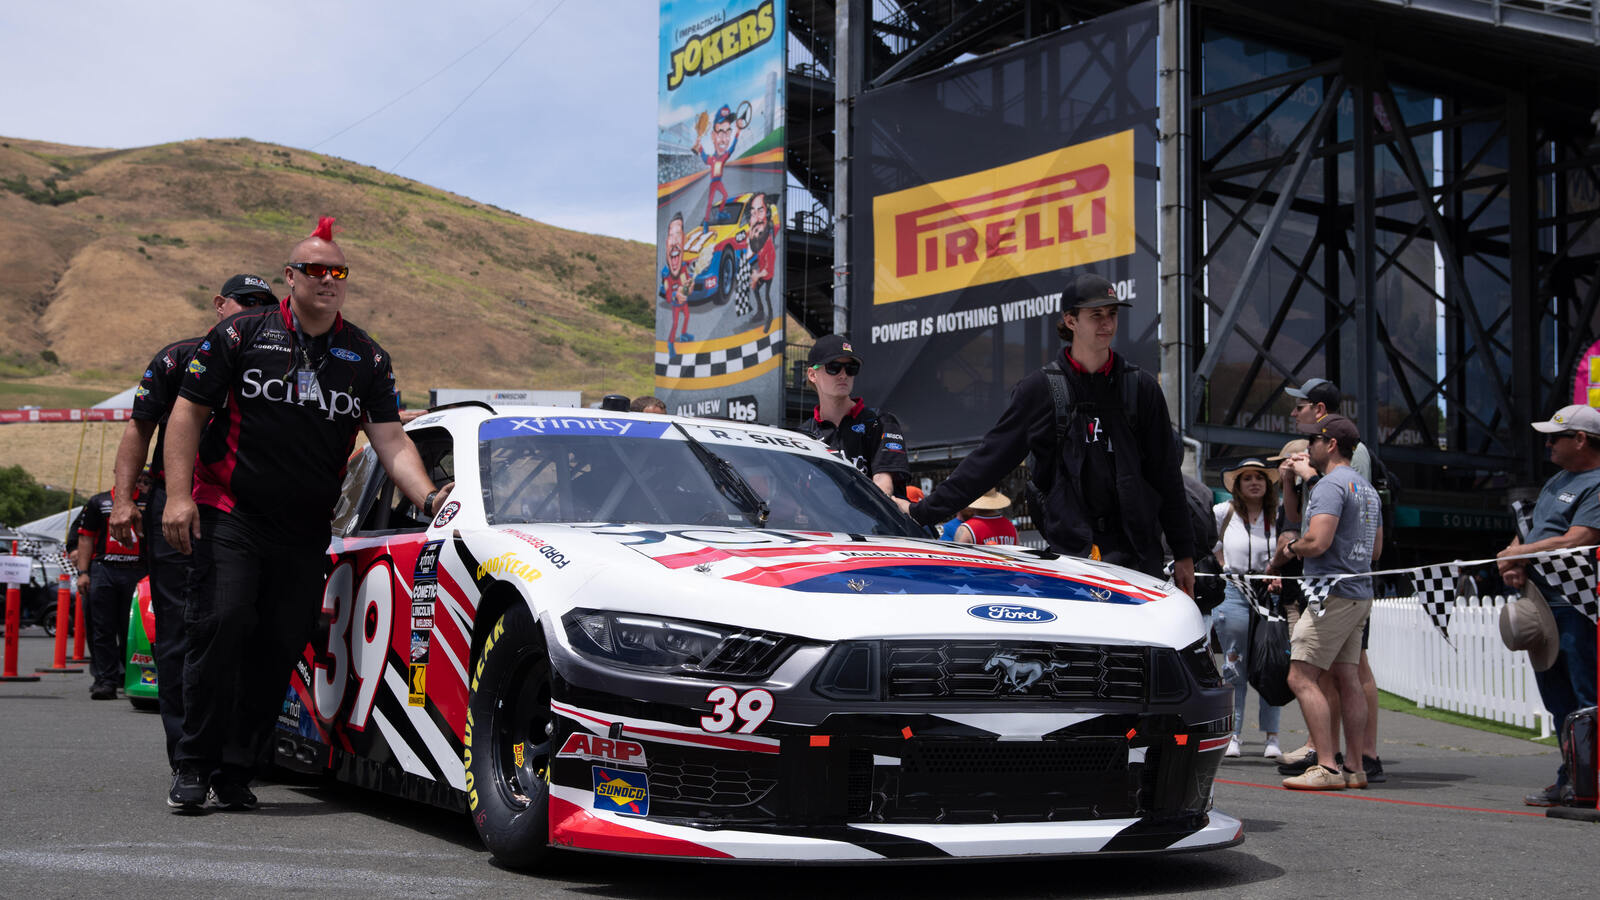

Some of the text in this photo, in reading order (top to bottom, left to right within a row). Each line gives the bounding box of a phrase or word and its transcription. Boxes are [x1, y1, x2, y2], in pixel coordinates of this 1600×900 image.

[668, 2, 775, 90] JOKERS
[895, 163, 1110, 278] PIRELLI
[871, 293, 1063, 345] POWER IS NOTHING WITHOUT
[263, 331, 285, 340] xfinity
[253, 344, 292, 352] GOODYEAR
[336, 350, 355, 360] Ford
[242, 368, 361, 421] SciAps
[677, 400, 721, 417] ALL NEW
[728, 401, 757, 421] tbs
[510, 417, 632, 434] xfinity
[709, 429, 812, 452] R. SIEG
[1441, 514, 1511, 528] SOUVENI
[419, 552, 437, 571] xfinity
[539, 545, 571, 569] FORD
[928, 554, 1015, 567] America
[476, 552, 543, 583] GOODYEAR
[413, 584, 437, 599] COMETIC
[988, 604, 1041, 622] Ford
[313, 561, 394, 732] 39
[700, 685, 774, 734] 39
[561, 733, 643, 761] ARP
[599, 783, 644, 800] SUNOCO
